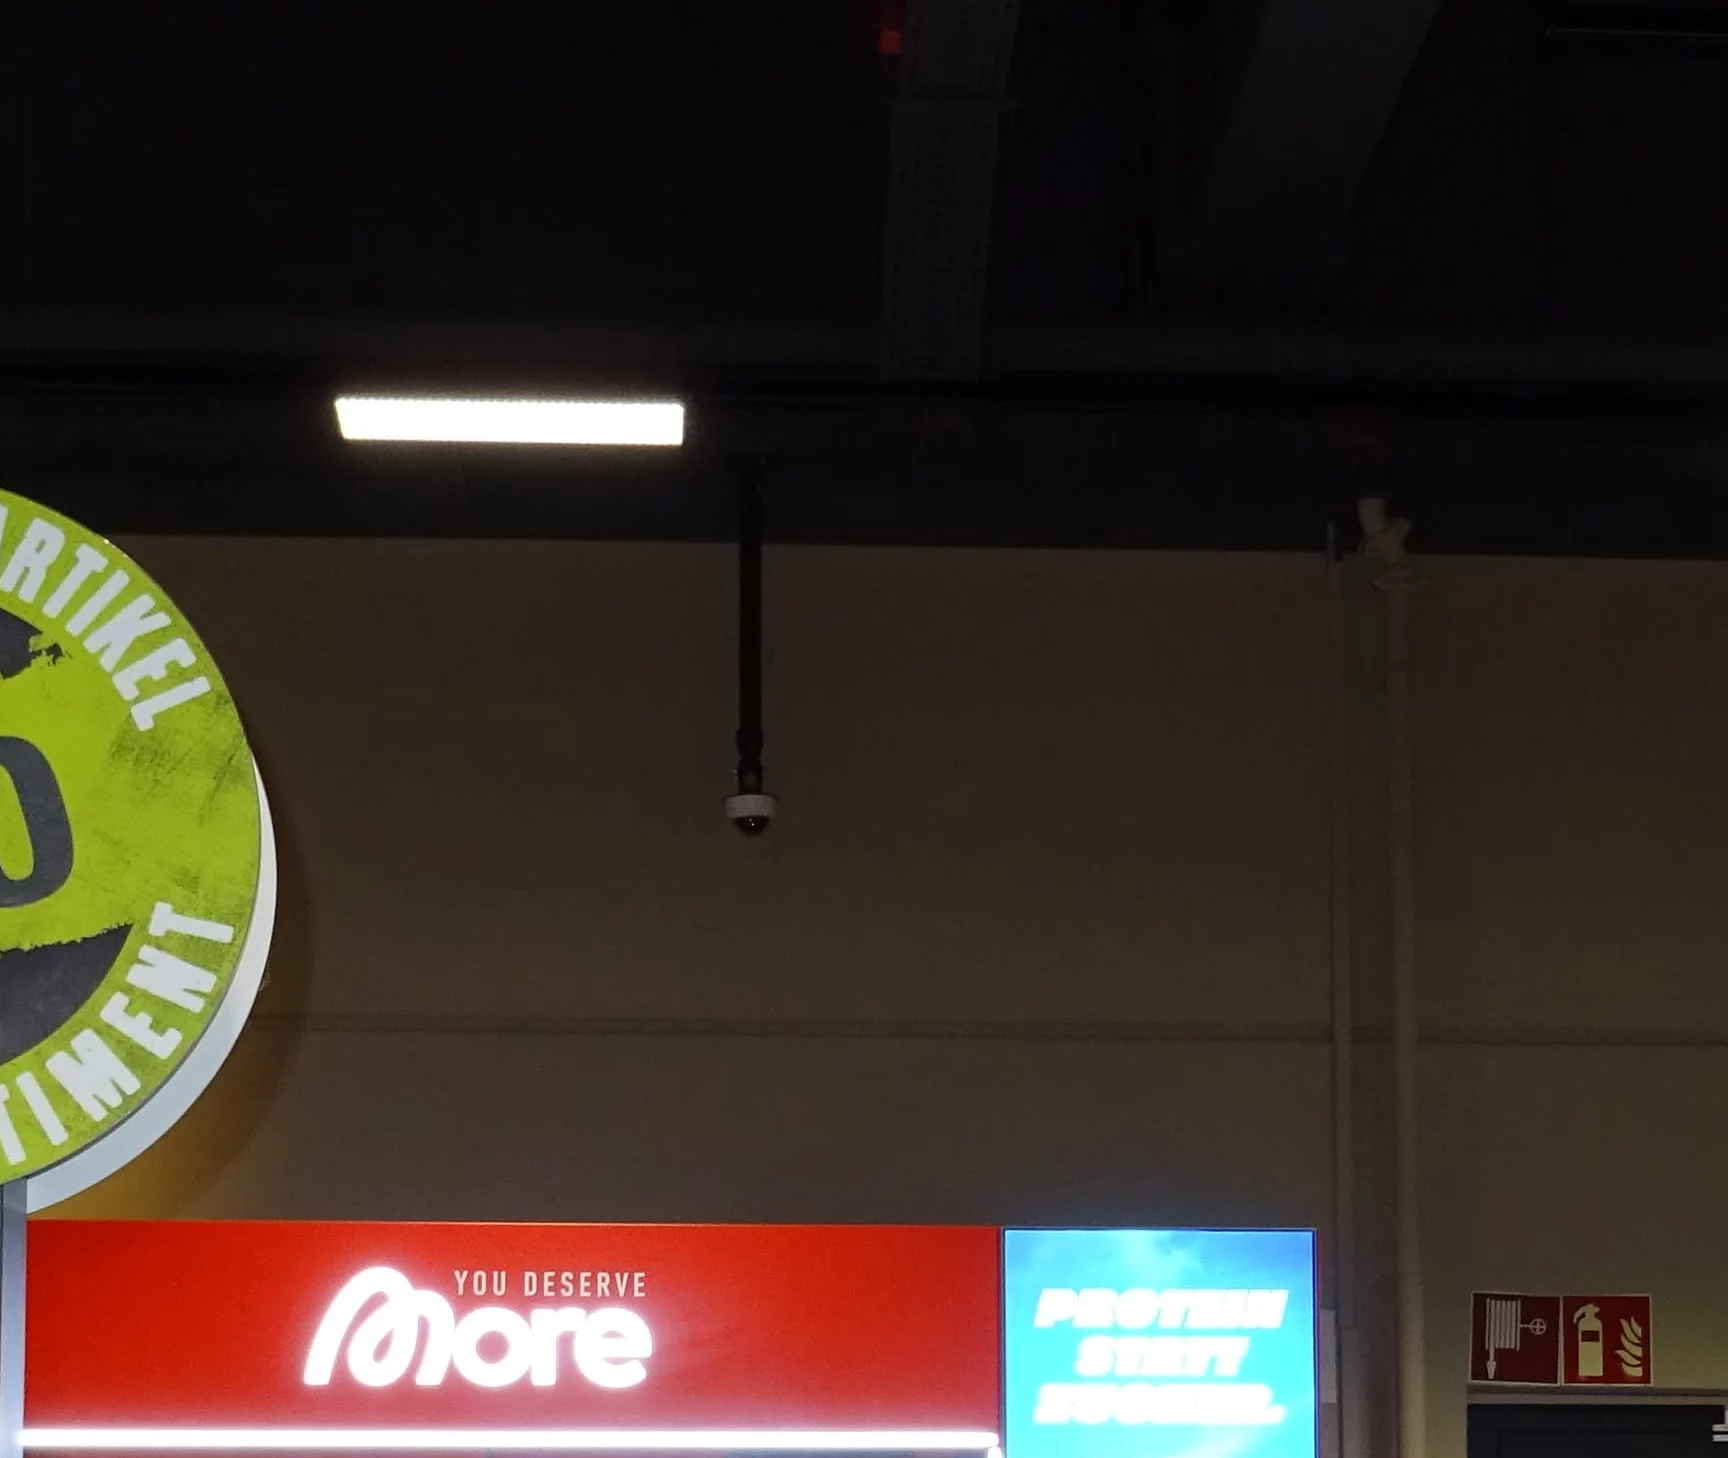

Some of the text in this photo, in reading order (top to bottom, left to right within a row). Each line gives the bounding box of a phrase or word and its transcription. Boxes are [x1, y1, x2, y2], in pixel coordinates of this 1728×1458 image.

[454, 1270, 648, 1299] YOU DESERVE
[303, 1266, 654, 1390] More
